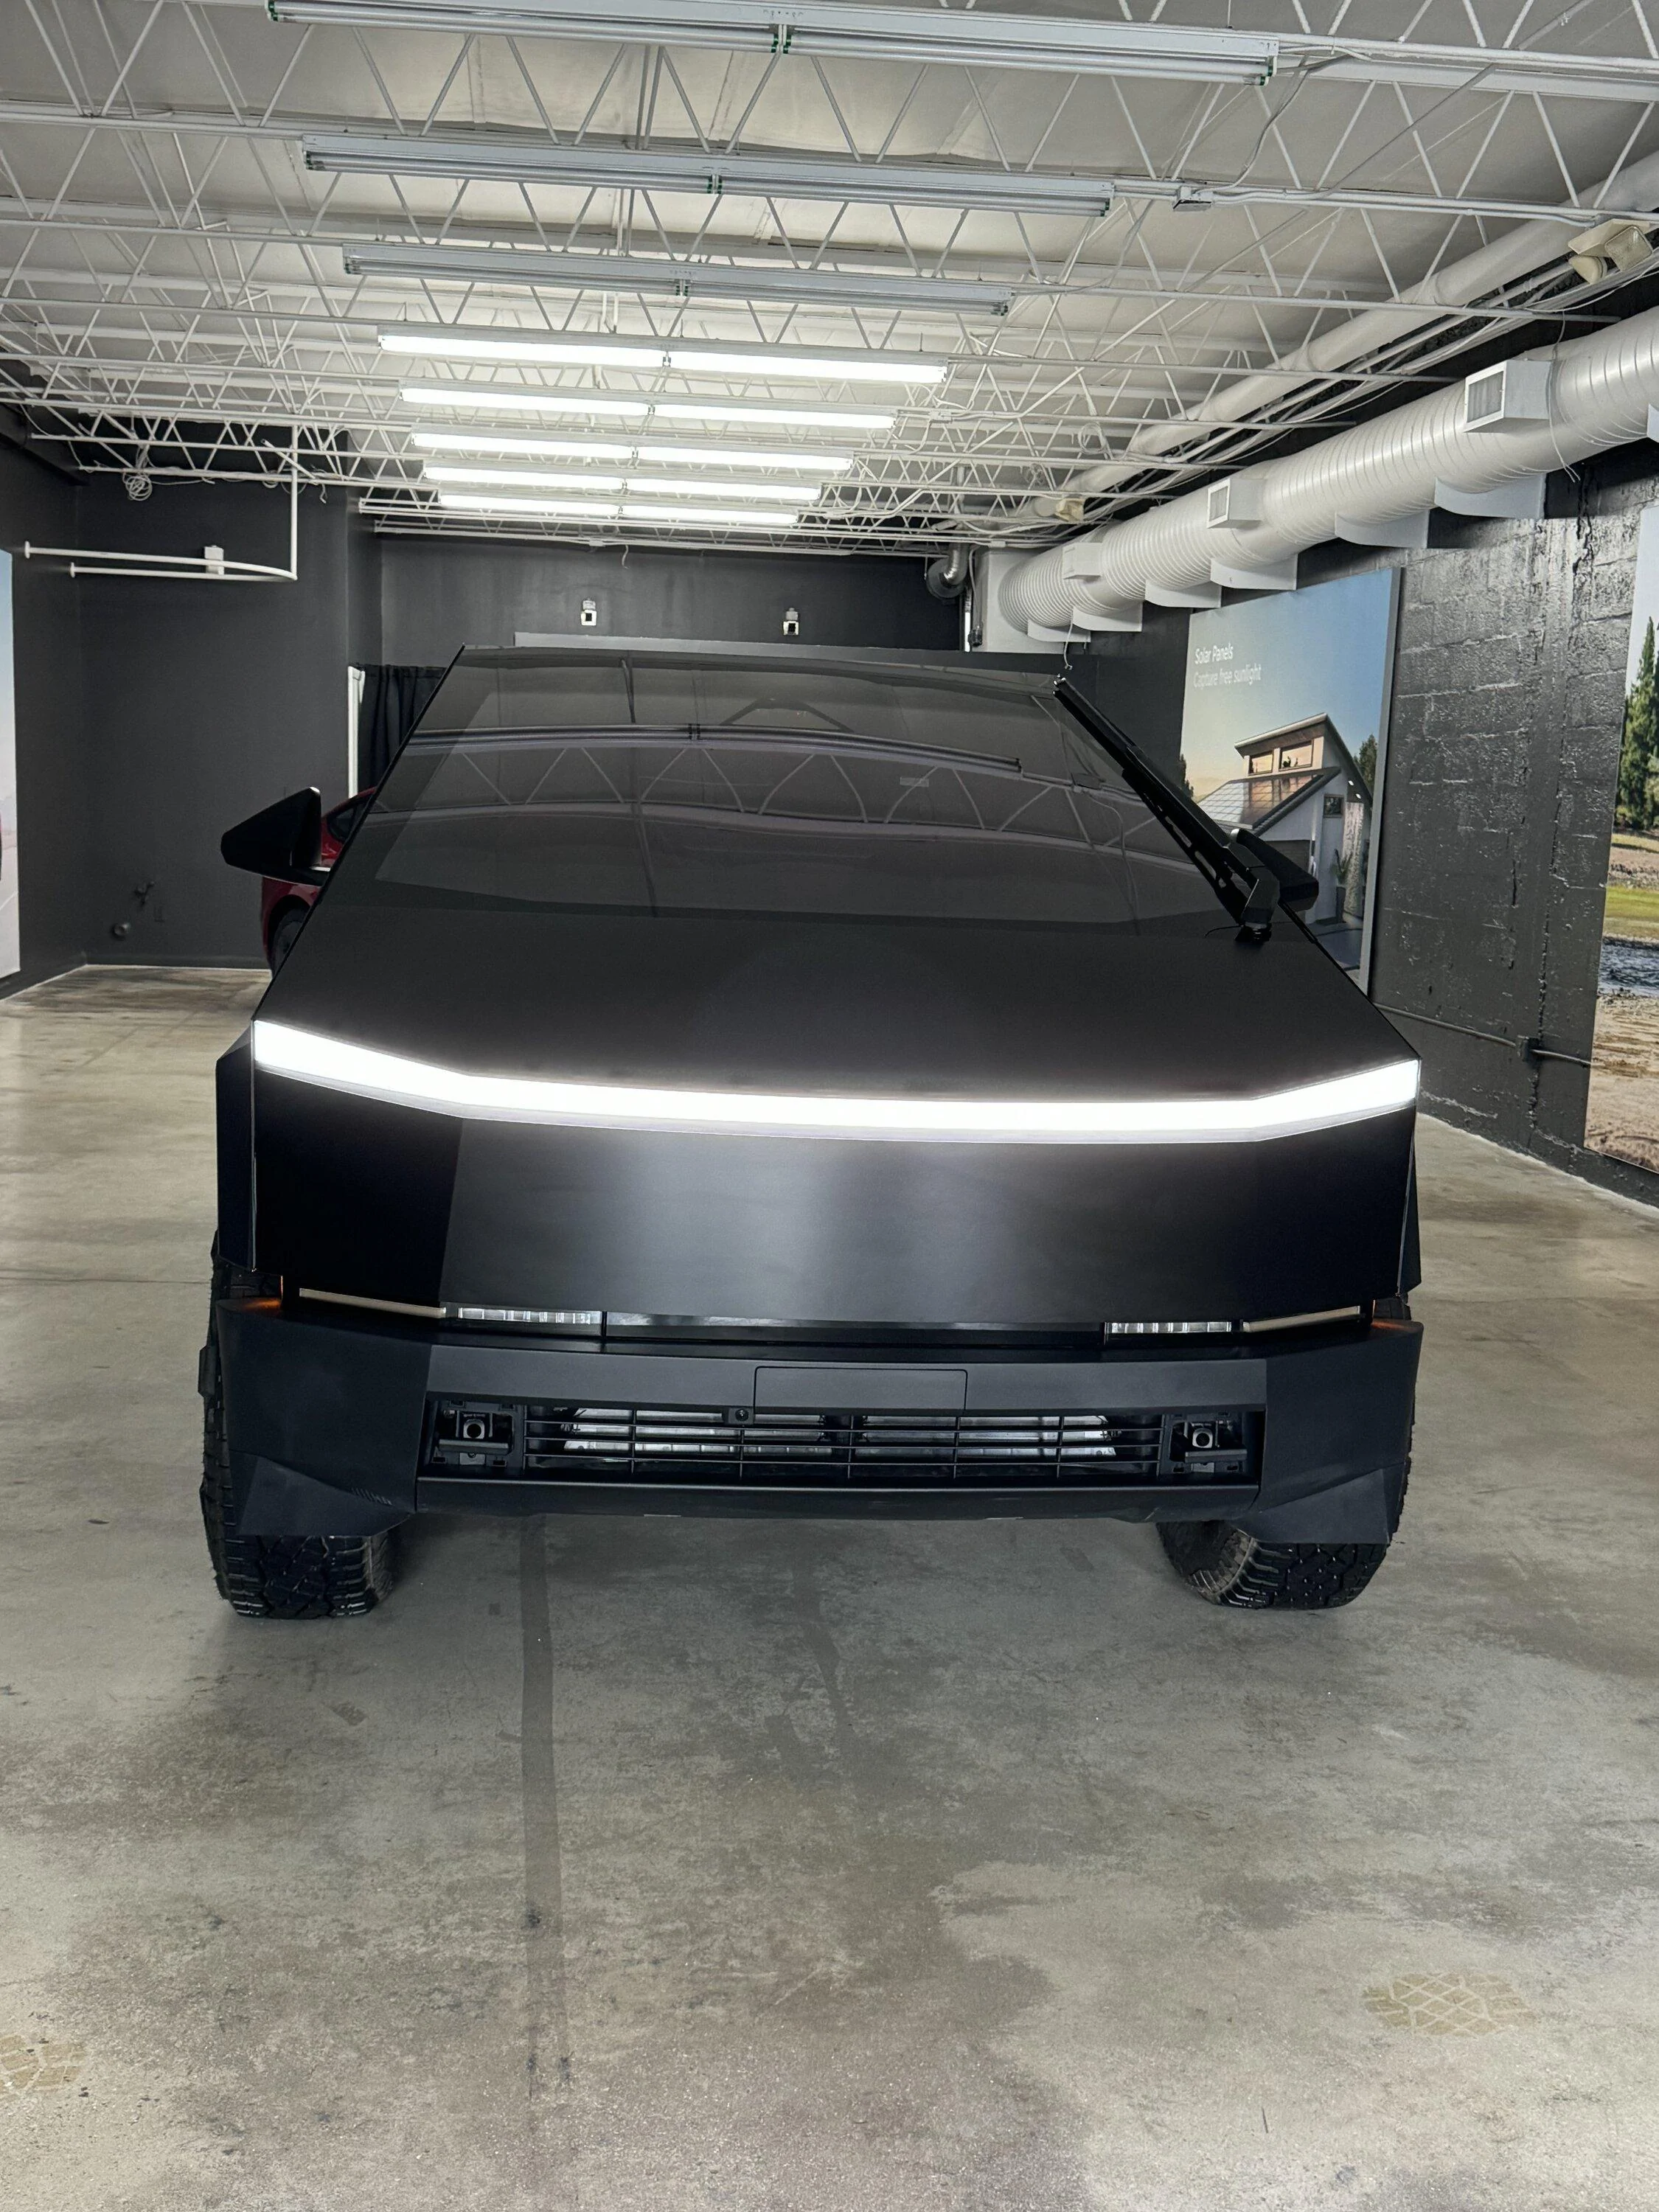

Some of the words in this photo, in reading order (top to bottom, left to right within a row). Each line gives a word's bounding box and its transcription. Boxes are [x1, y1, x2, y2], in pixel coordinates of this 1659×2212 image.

[1194, 647, 1211, 664] Solar
[1212, 641, 1234, 662] Panels
[1219, 668, 1233, 684] free
[1233, 663, 1262, 686] sunlight
